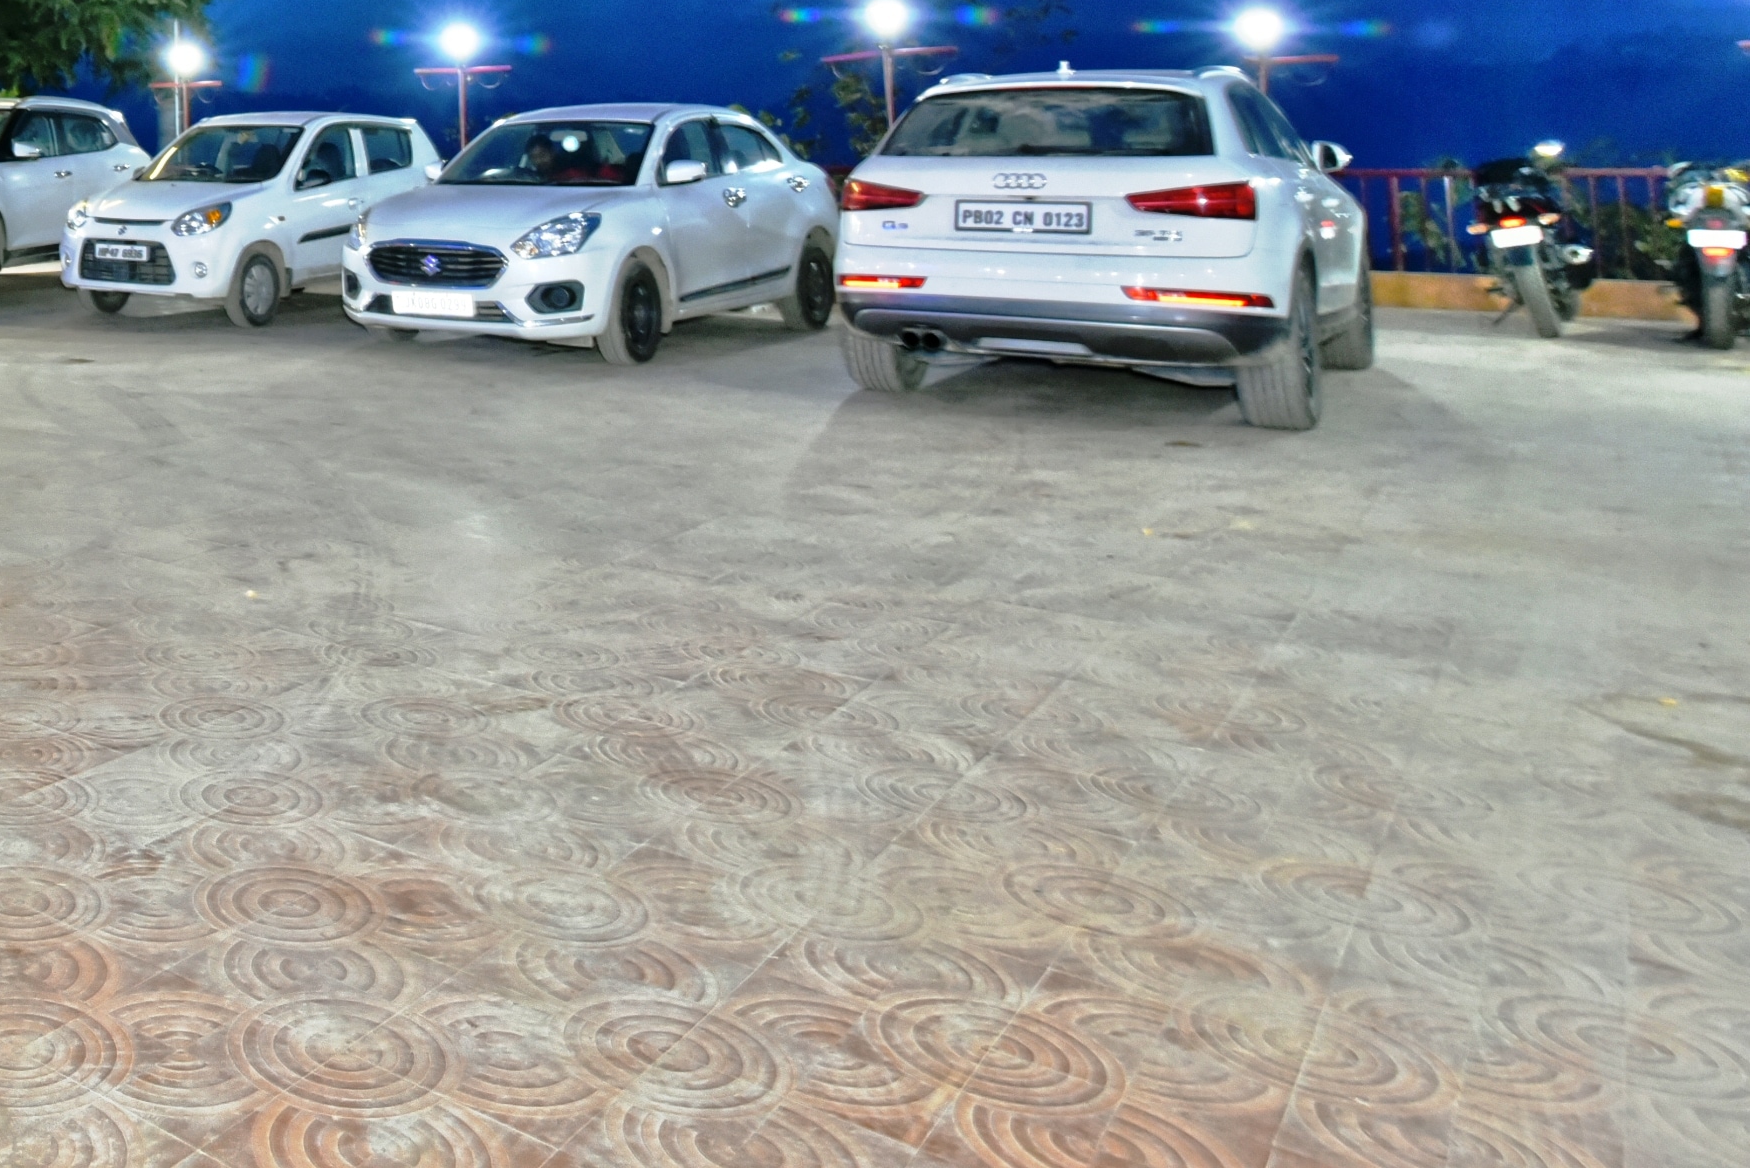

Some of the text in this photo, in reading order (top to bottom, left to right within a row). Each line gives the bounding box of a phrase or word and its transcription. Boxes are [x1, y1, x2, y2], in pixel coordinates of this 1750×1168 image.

[962, 209, 1085, 228] PB02 CN 0123
